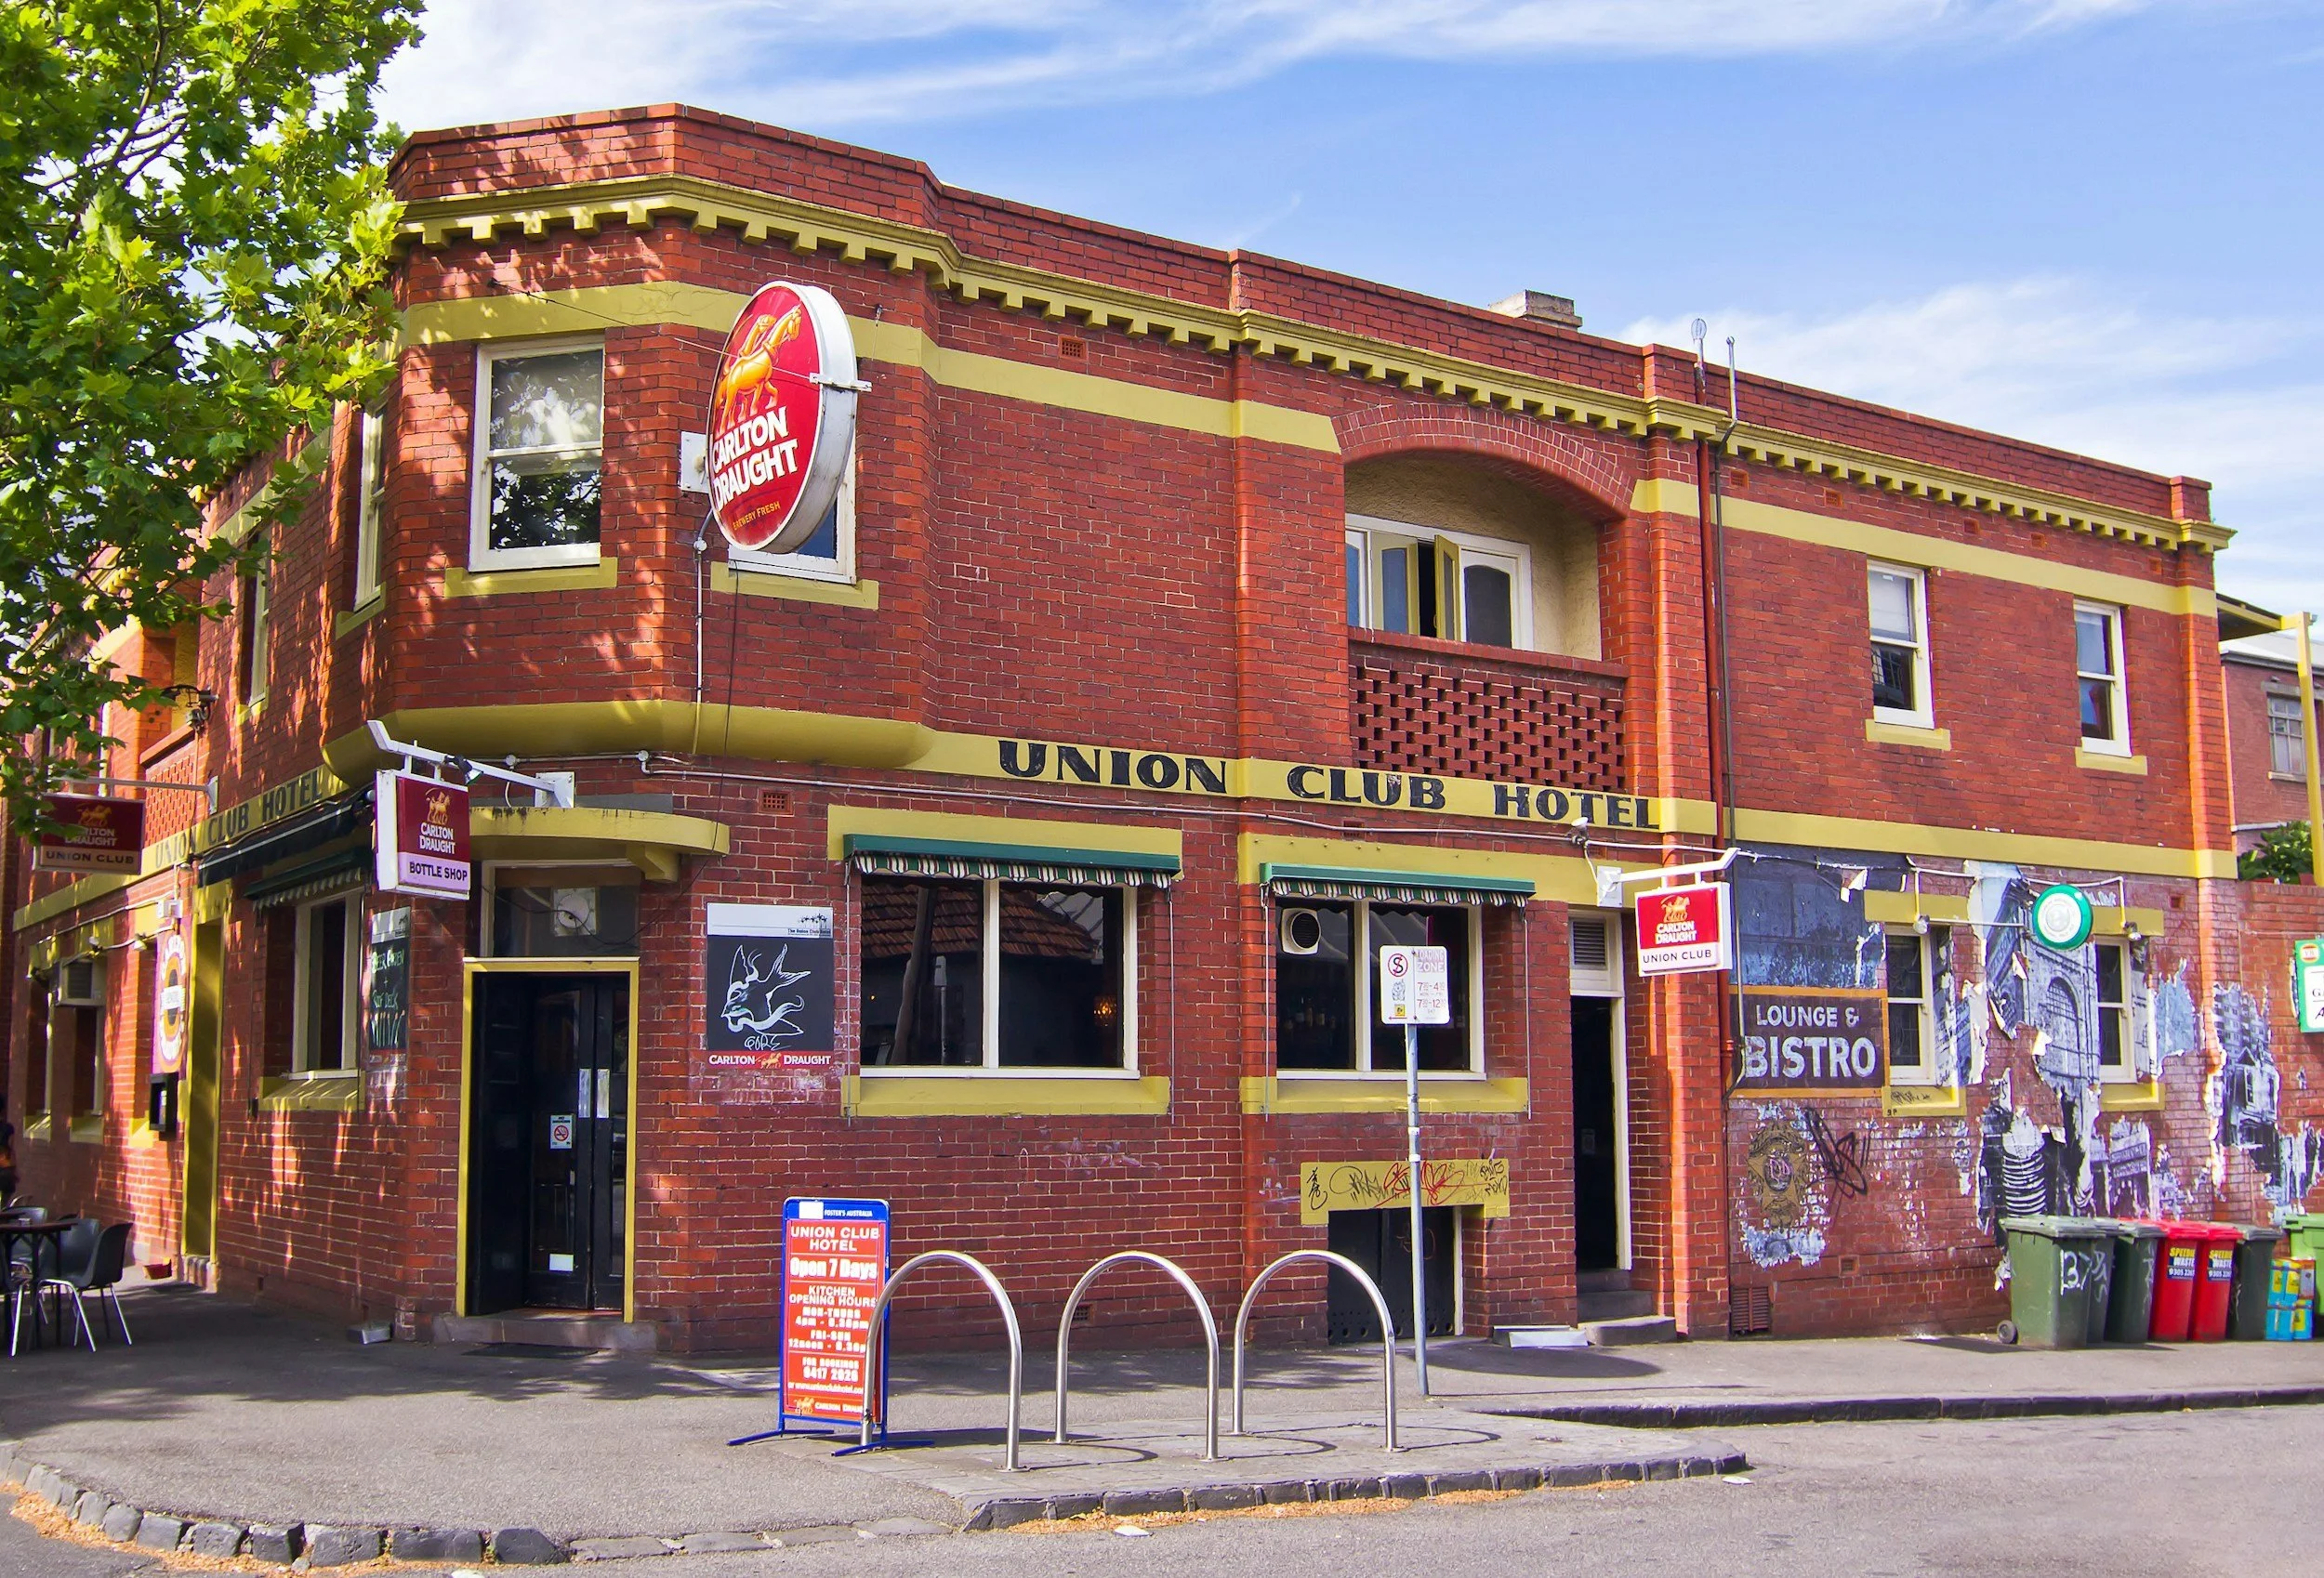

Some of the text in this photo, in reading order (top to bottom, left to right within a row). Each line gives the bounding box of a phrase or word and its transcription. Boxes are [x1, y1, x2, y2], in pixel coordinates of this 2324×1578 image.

[712, 406, 788, 474] CARLTON
[714, 439, 799, 512] DRAUGHT
[733, 501, 781, 531] BREWERY FRESH
[997, 740, 1660, 829] UNION CLUB HOTEL
[155, 769, 324, 869] UNION CLUB HOTEL
[420, 822, 454, 840] CARLTON
[419, 835, 456, 854] DRAUGHT
[46, 850, 134, 864] UNION CLUB
[409, 861, 468, 881] BOTTLE SHOP
[1656, 920, 1695, 933] CARLTON
[1655, 930, 1697, 945] DRAUGHT
[1643, 949, 1712, 963] UNION CLUB
[1417, 962, 1445, 973] ZONE
[1756, 1005, 1860, 1028] LOUNGE &
[708, 1054, 832, 1065] CARLTON DRAUGHT
[1744, 1035, 1876, 1078] BISTRO
[791, 1226, 880, 1240] UNION CLUB
[810, 1239, 857, 1252] HOTEL
[790, 1256, 827, 1278] Open
[828, 1257, 838, 1278] 7
[839, 1258, 878, 1281] Days
[808, 1285, 856, 1296] KITCHEN
[788, 1294, 878, 1308] OPENING HOURS
